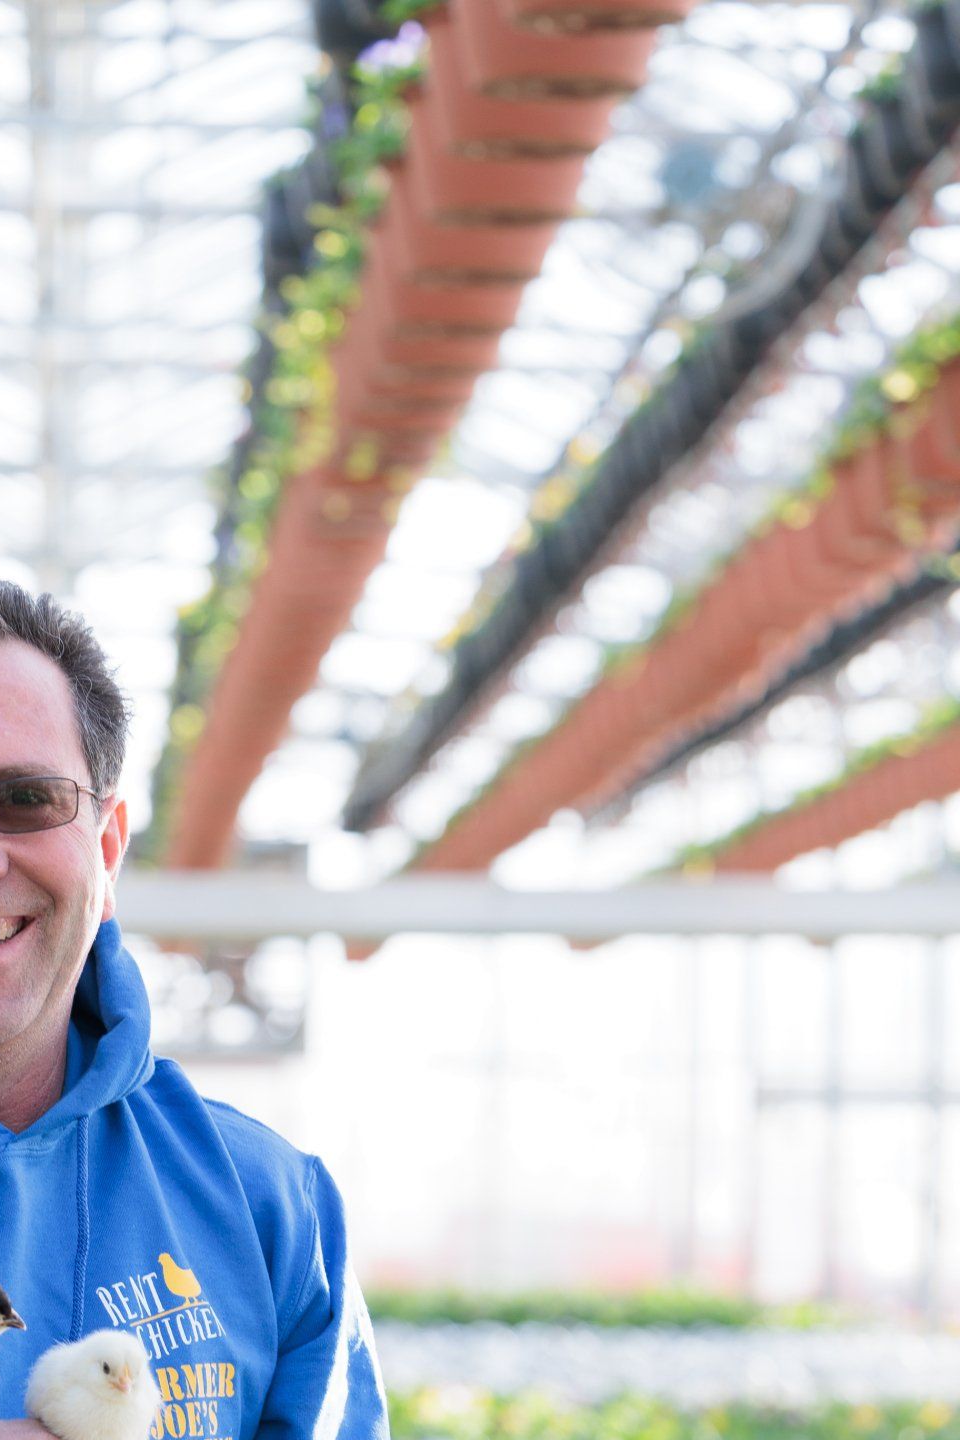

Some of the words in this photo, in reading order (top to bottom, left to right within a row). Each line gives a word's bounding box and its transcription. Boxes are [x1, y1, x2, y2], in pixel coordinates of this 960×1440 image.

[95, 1272, 165, 1327] RENT
[135, 1305, 227, 1360] CHICKEN
[155, 1362, 236, 1402] RMER
[150, 1400, 218, 1440] JOE'S
